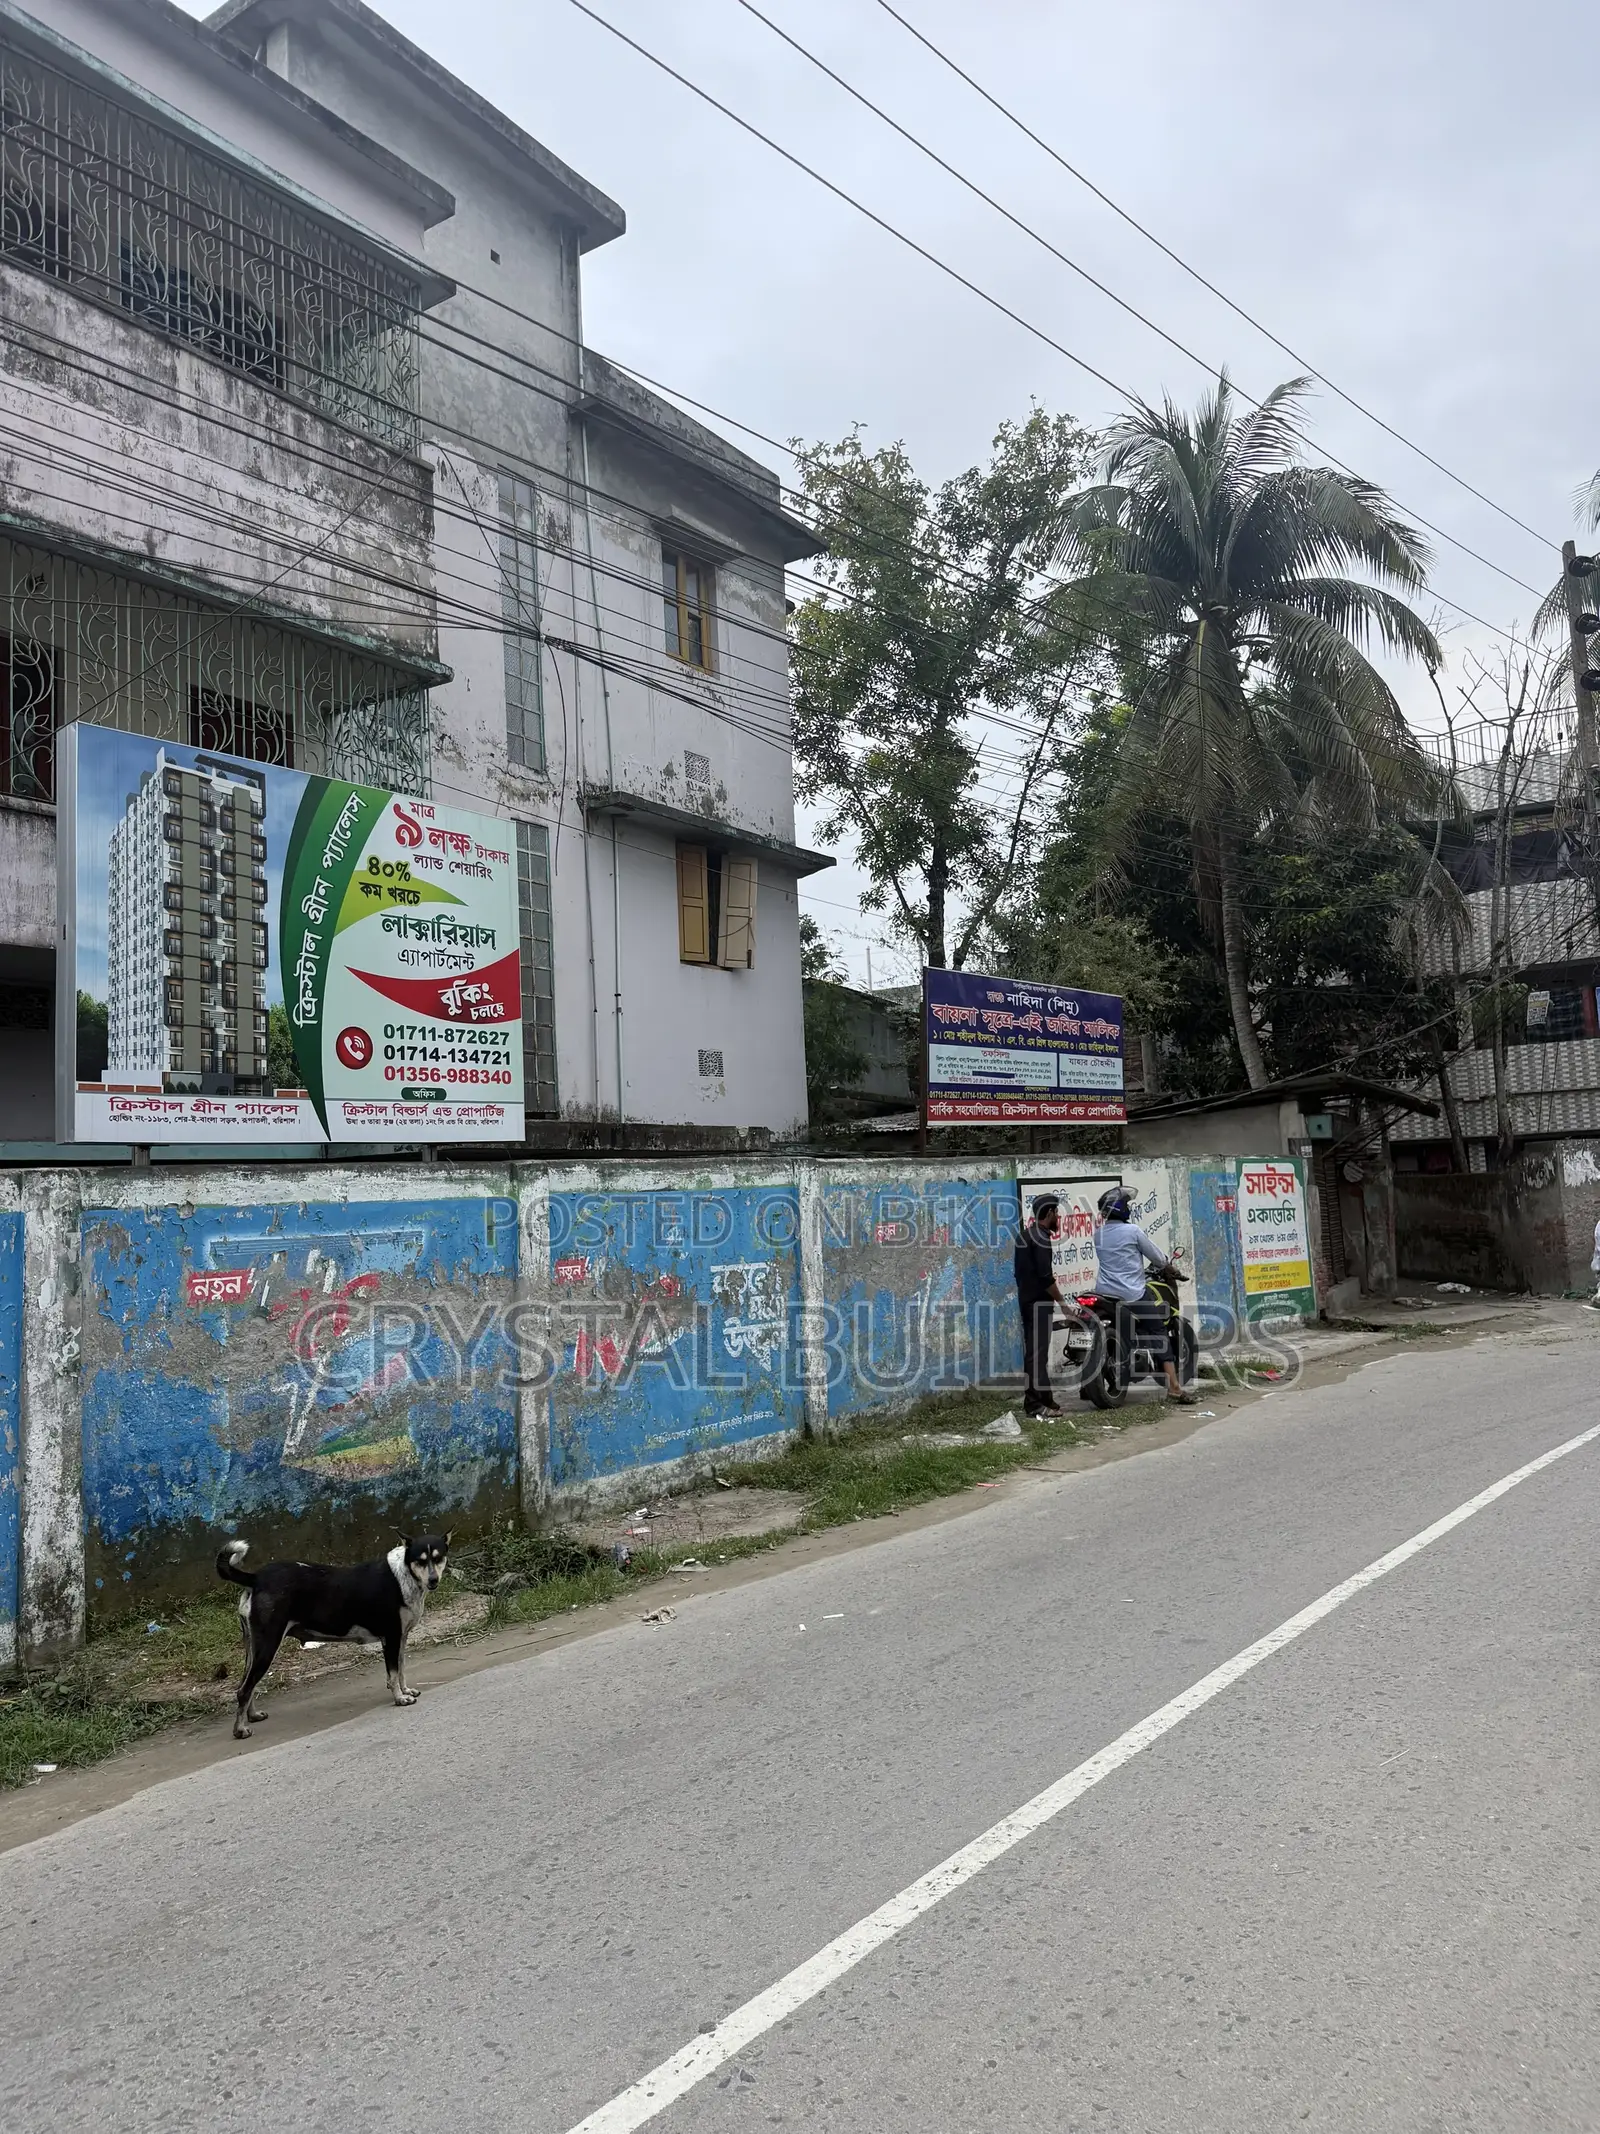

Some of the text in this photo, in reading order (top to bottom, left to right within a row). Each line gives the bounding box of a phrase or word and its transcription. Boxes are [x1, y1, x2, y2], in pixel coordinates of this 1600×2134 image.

[409, 801, 435, 820] মাত্র
[393, 803, 510, 865] ৯ লক্ষ টাকায়
[367, 856, 411, 883] ৪০%
[413, 853, 494, 881] ল্যান্ড শেয়ারিং
[358, 881, 421, 905] কম খরচে
[293, 790, 368, 1028] ক্রিস্টাল গ্রীন প্যালেস
[380, 913, 497, 950] লাক্সারিয়াস
[398, 948, 476, 971] এ্যাপার্টমেন্ট
[437, 979, 494, 1016] বুকিং
[1006, 991, 1044, 1009] নাহিদা
[1047, 996, 1079, 1016] (শিমু)
[470, 1002, 505, 1021] চলছে
[931, 1003, 979, 1027] বায়না
[1044, 1013, 1081, 1036] জমির
[1082, 1018, 1121, 1040] মালিক
[384, 1024, 510, 1046] 01711-872627
[384, 1045, 511, 1065] 01714-134721
[384, 1066, 512, 1085] 01356-988340
[108, 1096, 300, 1115] ক্রিস্টাল গ্রীন প্যালেস
[412, 1088, 436, 1099] অফিস
[342, 1102, 388, 1116] ক্রিস্টাল
[457, 1104, 505, 1117] প্রোপার্টিজ
[929, 1101, 954, 1116] সার্বিক
[1001, 1102, 1038, 1116] ক্রিস্টাল
[1244, 1164, 1295, 1198] সাইন্স
[1247, 1199, 1296, 1226] একাডেমি
[557, 1264, 582, 1279] নতুন
[192, 1276, 242, 1302] নতুন
